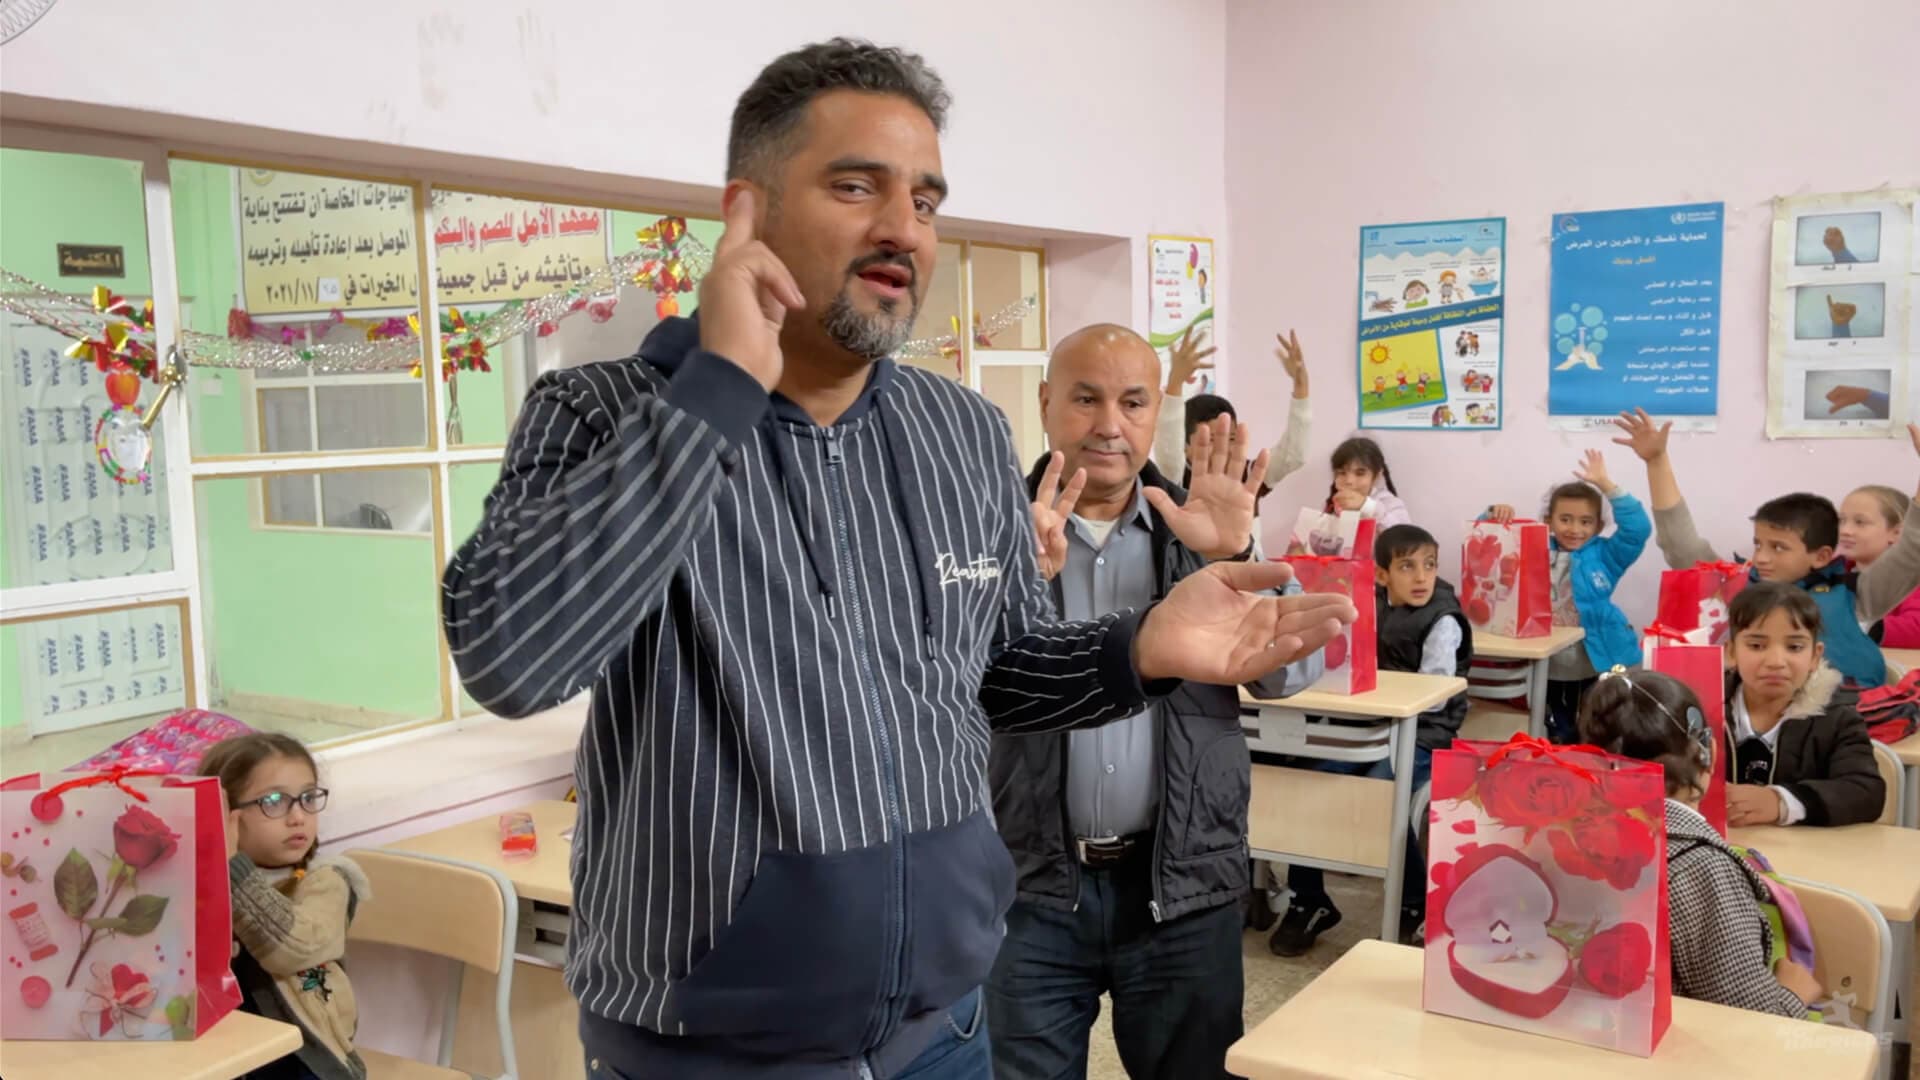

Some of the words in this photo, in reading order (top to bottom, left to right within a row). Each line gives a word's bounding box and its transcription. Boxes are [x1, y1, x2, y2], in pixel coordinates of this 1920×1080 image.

[243, 196, 270, 224] بناية
[321, 187, 360, 209] الخاصة
[434, 216, 476, 257] والبكم
[480, 211, 515, 254] للصم
[559, 208, 600, 238] معهد
[355, 236, 373, 259] بعد
[377, 229, 410, 256] الموصل
[436, 266, 475, 296] جمعية
[480, 262, 506, 293] قبل
[512, 265, 529, 292] من
